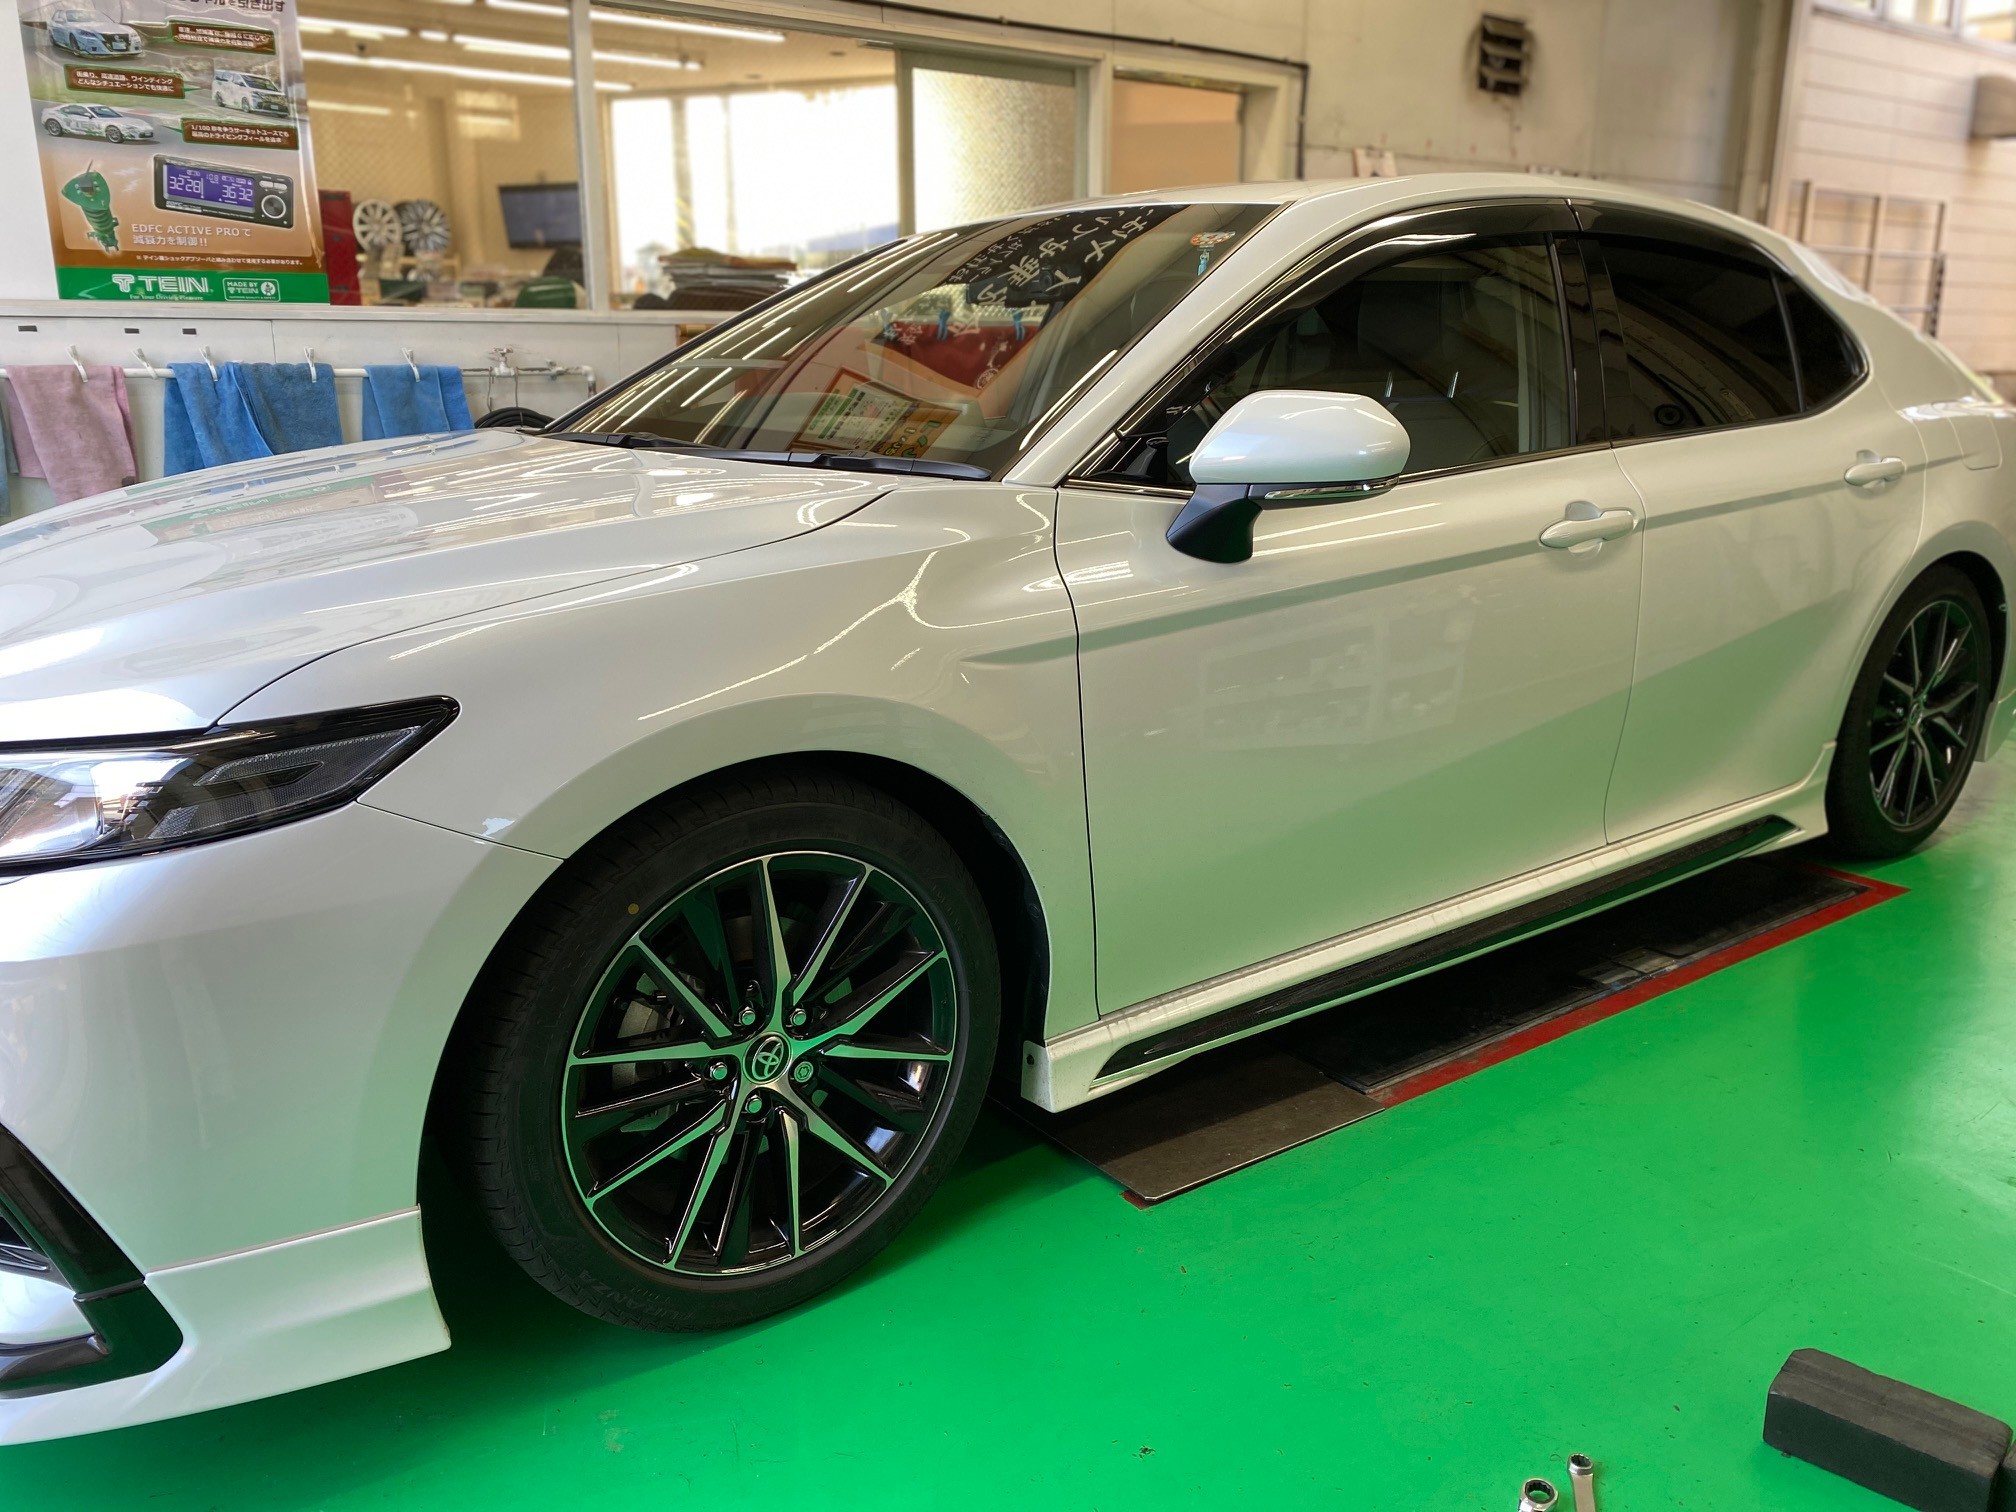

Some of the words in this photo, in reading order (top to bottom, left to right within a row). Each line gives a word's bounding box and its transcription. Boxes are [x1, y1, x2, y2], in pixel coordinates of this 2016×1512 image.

[131, 223, 163, 233] EDFC
[167, 225, 213, 236] ACTIVE
[216, 227, 240, 237] PRO
[138, 275, 210, 293] TEIN
